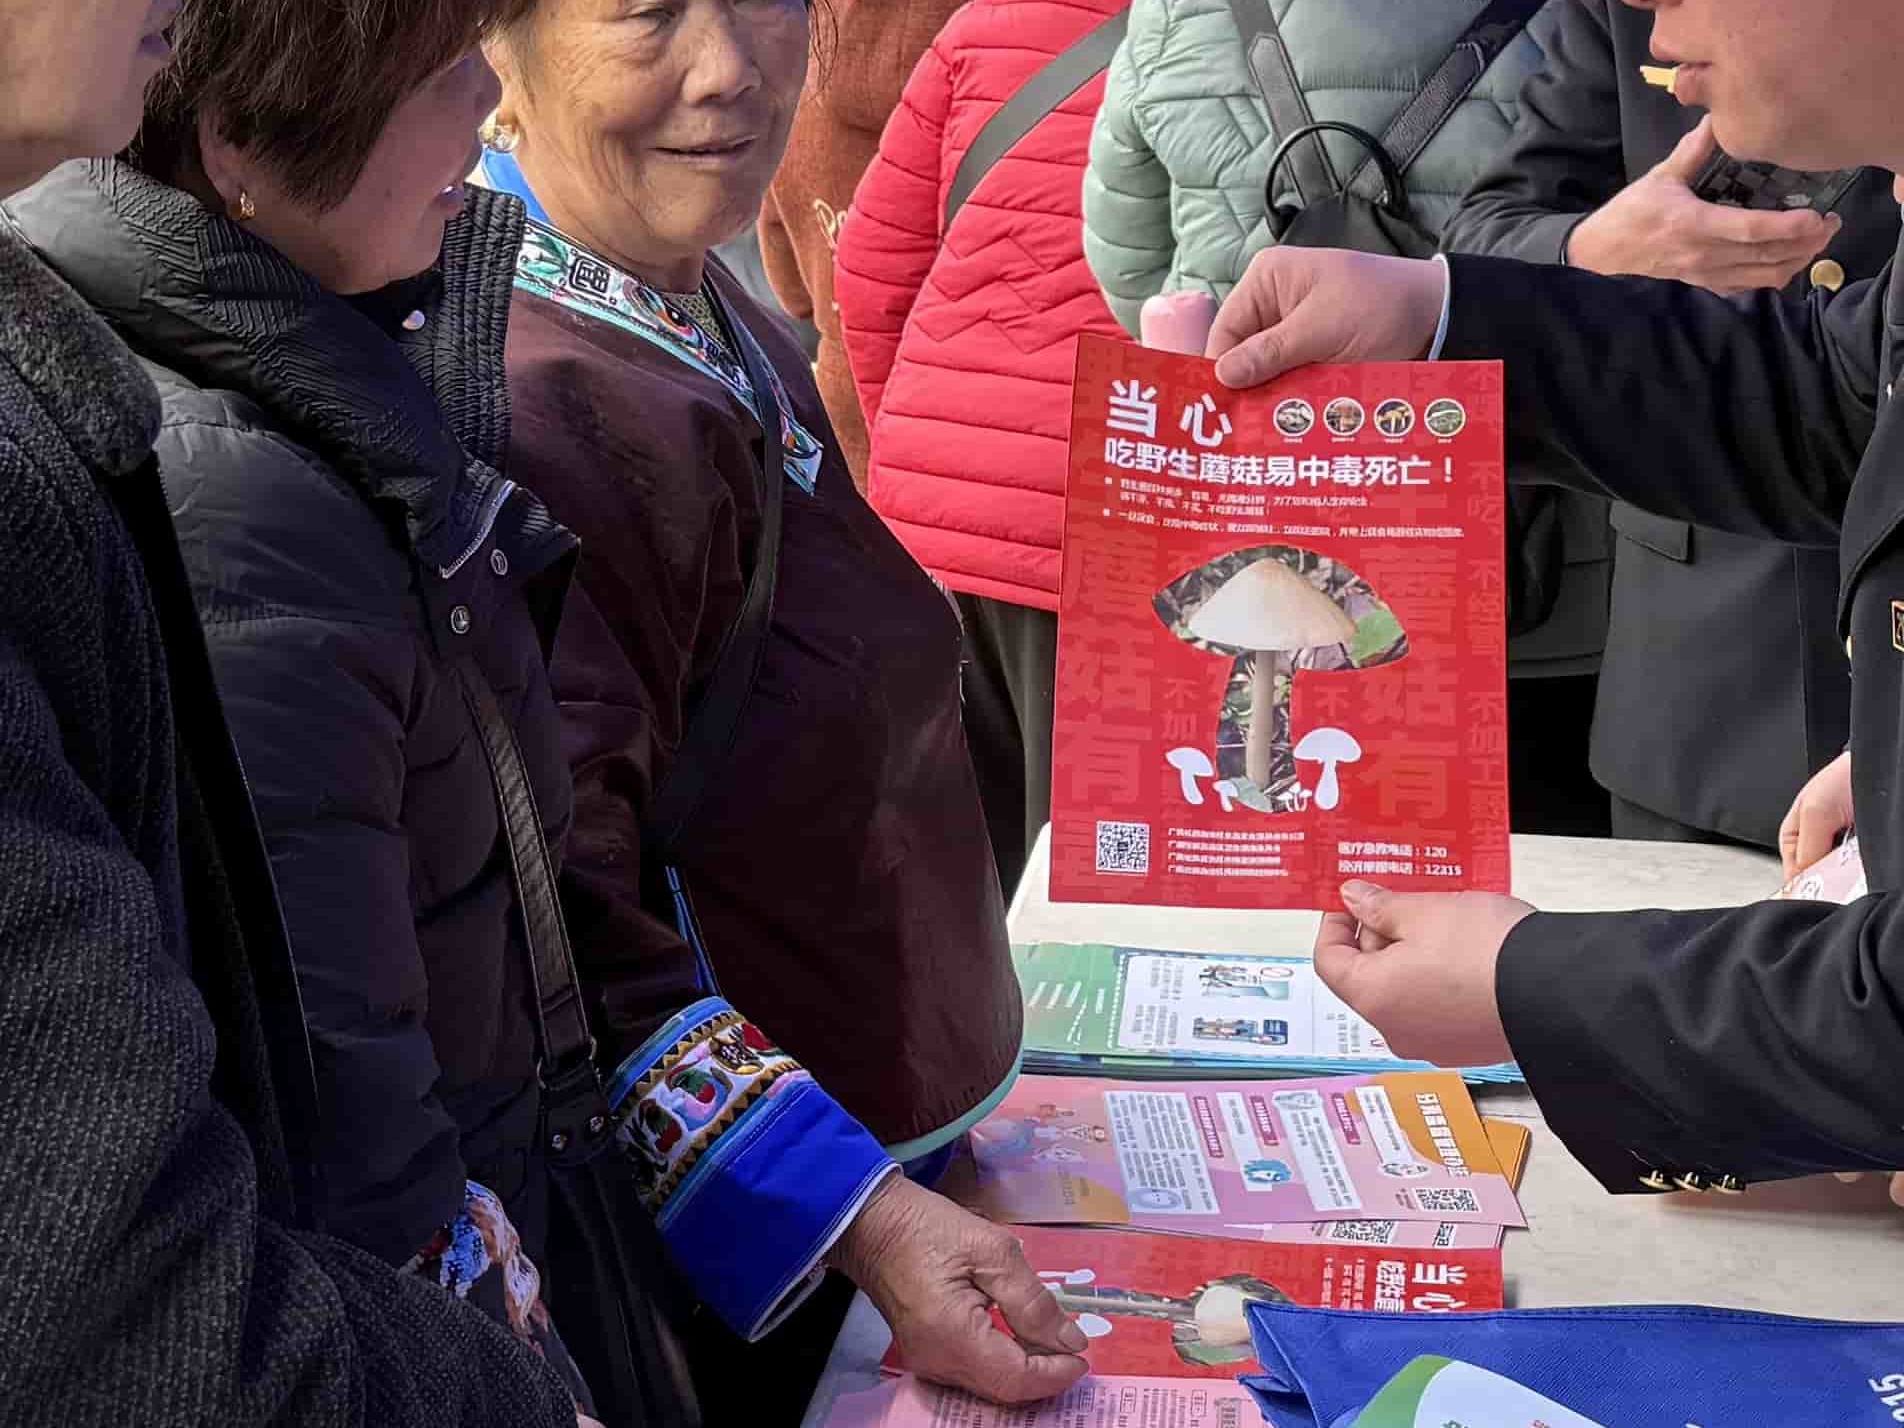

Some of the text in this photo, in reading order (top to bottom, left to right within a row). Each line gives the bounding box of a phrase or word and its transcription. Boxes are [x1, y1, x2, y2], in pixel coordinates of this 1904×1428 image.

[1106, 380, 1233, 448] 当心
[1104, 439, 1453, 487] 吃野生蘑菇易中毒死亡！
